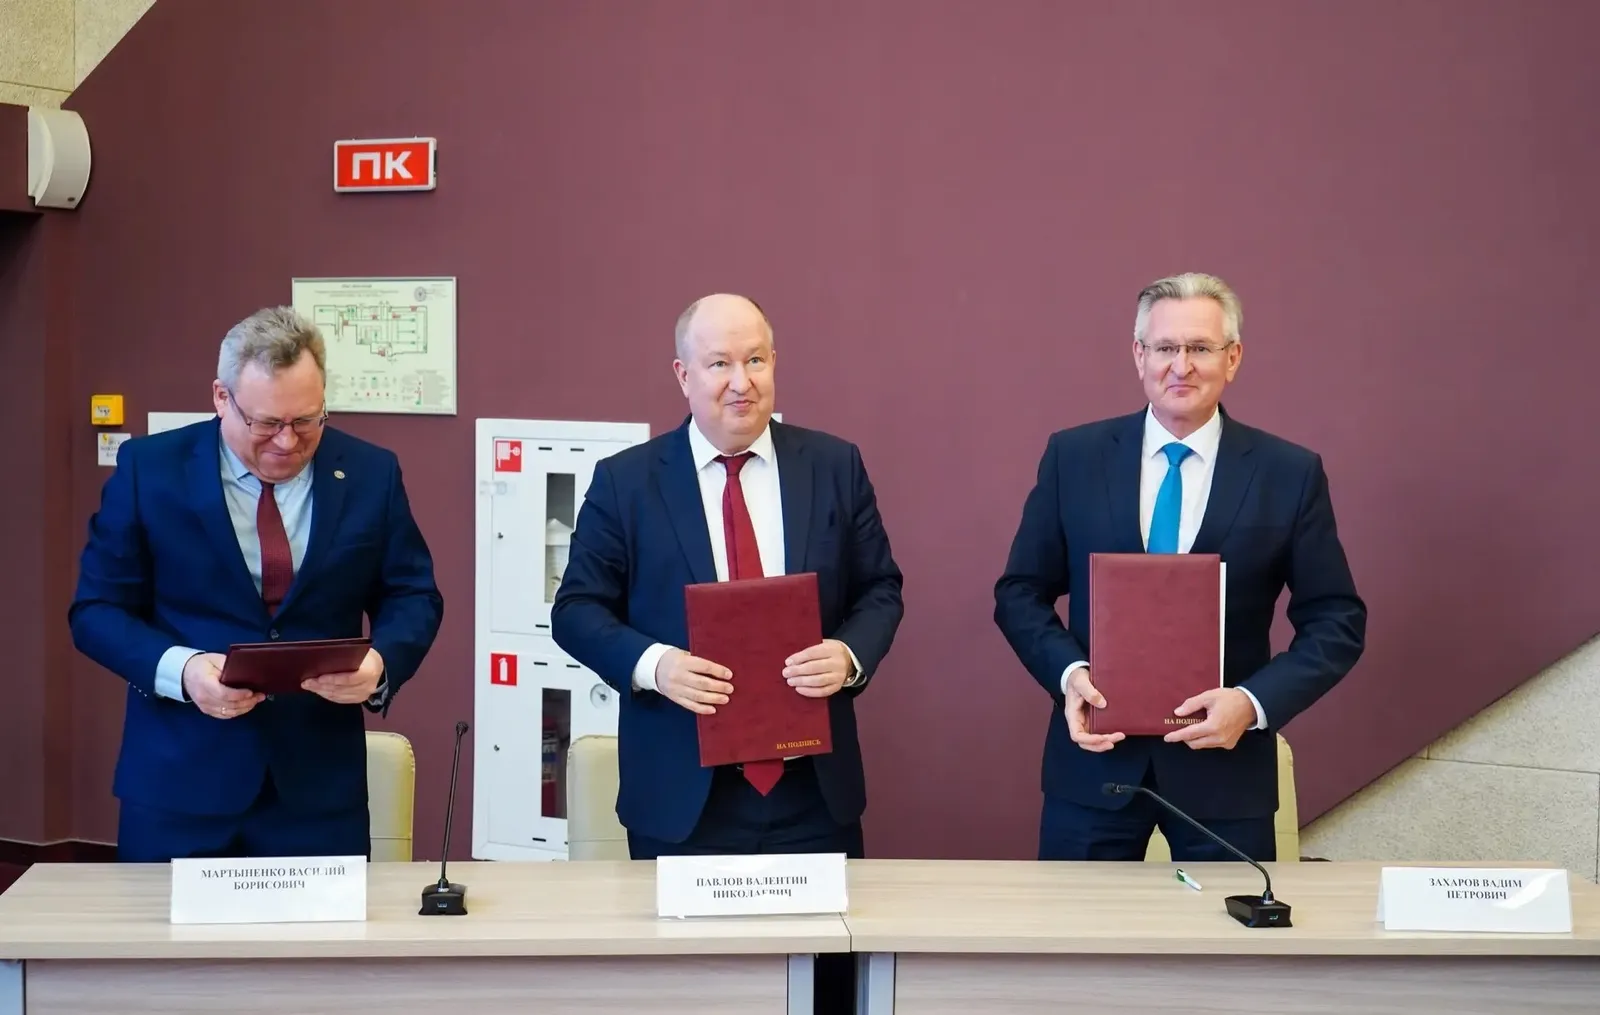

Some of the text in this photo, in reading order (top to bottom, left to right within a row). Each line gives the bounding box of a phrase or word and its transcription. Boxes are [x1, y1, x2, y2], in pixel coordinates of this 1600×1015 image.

[352, 151, 413, 180] ПК
[787, 739, 821, 748] ПОДПИСЬ
[201, 868, 286, 878] МАРТЫНЕНКО
[234, 880, 305, 890] БОРИСОВИЧ
[696, 876, 807, 887] ПАВЛОВ ВАЛЕНТИН
[1429, 878, 1522, 888] ЗАХАРОВ ВАДИМ
[1447, 890, 1507, 900] ПЕТРОВИЧ
